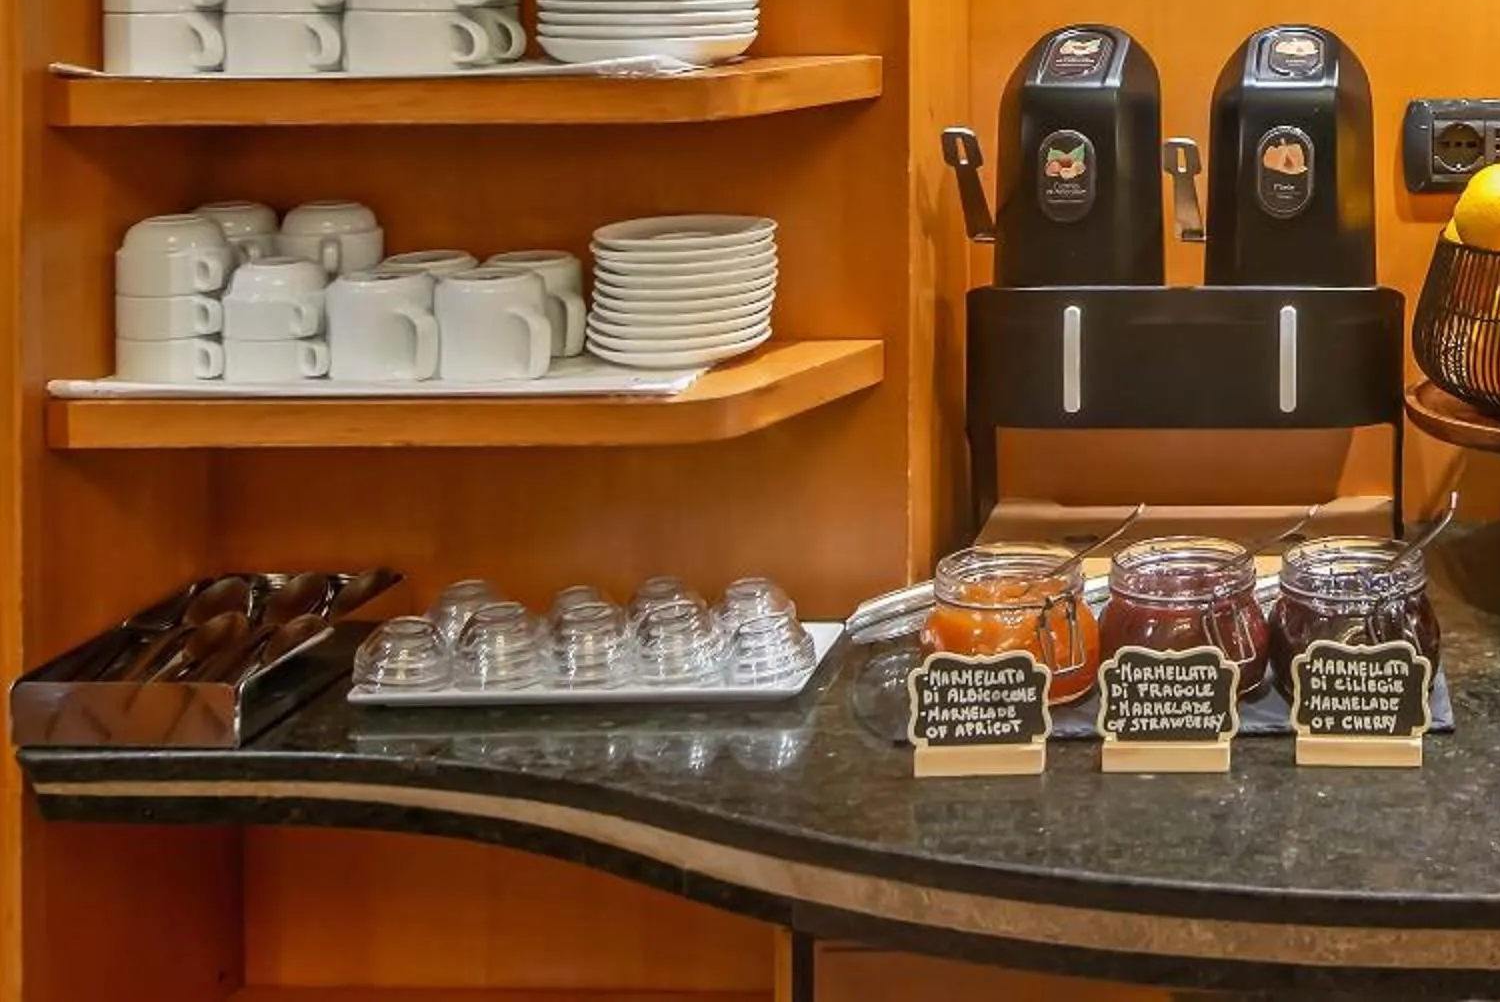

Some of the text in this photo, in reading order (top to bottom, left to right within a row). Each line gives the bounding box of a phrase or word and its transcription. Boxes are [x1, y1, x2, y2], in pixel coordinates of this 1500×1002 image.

[1138, 683, 1215, 698] FRAGOLE
[1309, 695, 1400, 712] MARMELADE
[1107, 711, 1227, 733] OF STRAWBERRY
[1311, 714, 1398, 734] OF CHERRY
[925, 725, 947, 738] OF
